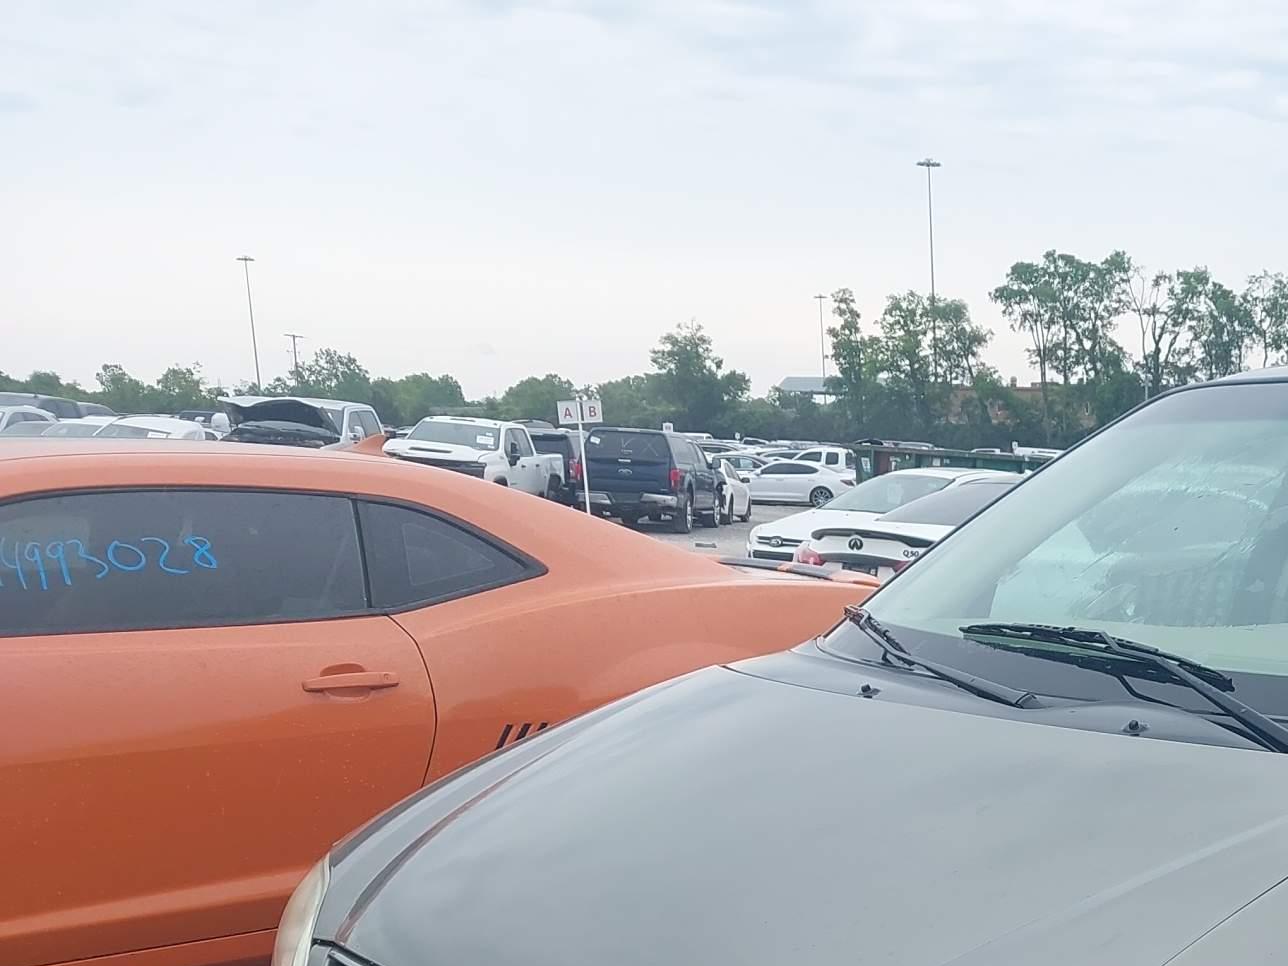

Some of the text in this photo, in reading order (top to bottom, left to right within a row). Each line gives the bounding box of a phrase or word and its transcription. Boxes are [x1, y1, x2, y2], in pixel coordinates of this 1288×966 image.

[563, 407, 573, 419] A
[588, 406, 598, 418] B
[902, 549, 920, 559] Q50
[0, 536, 217, 590] 4993028
